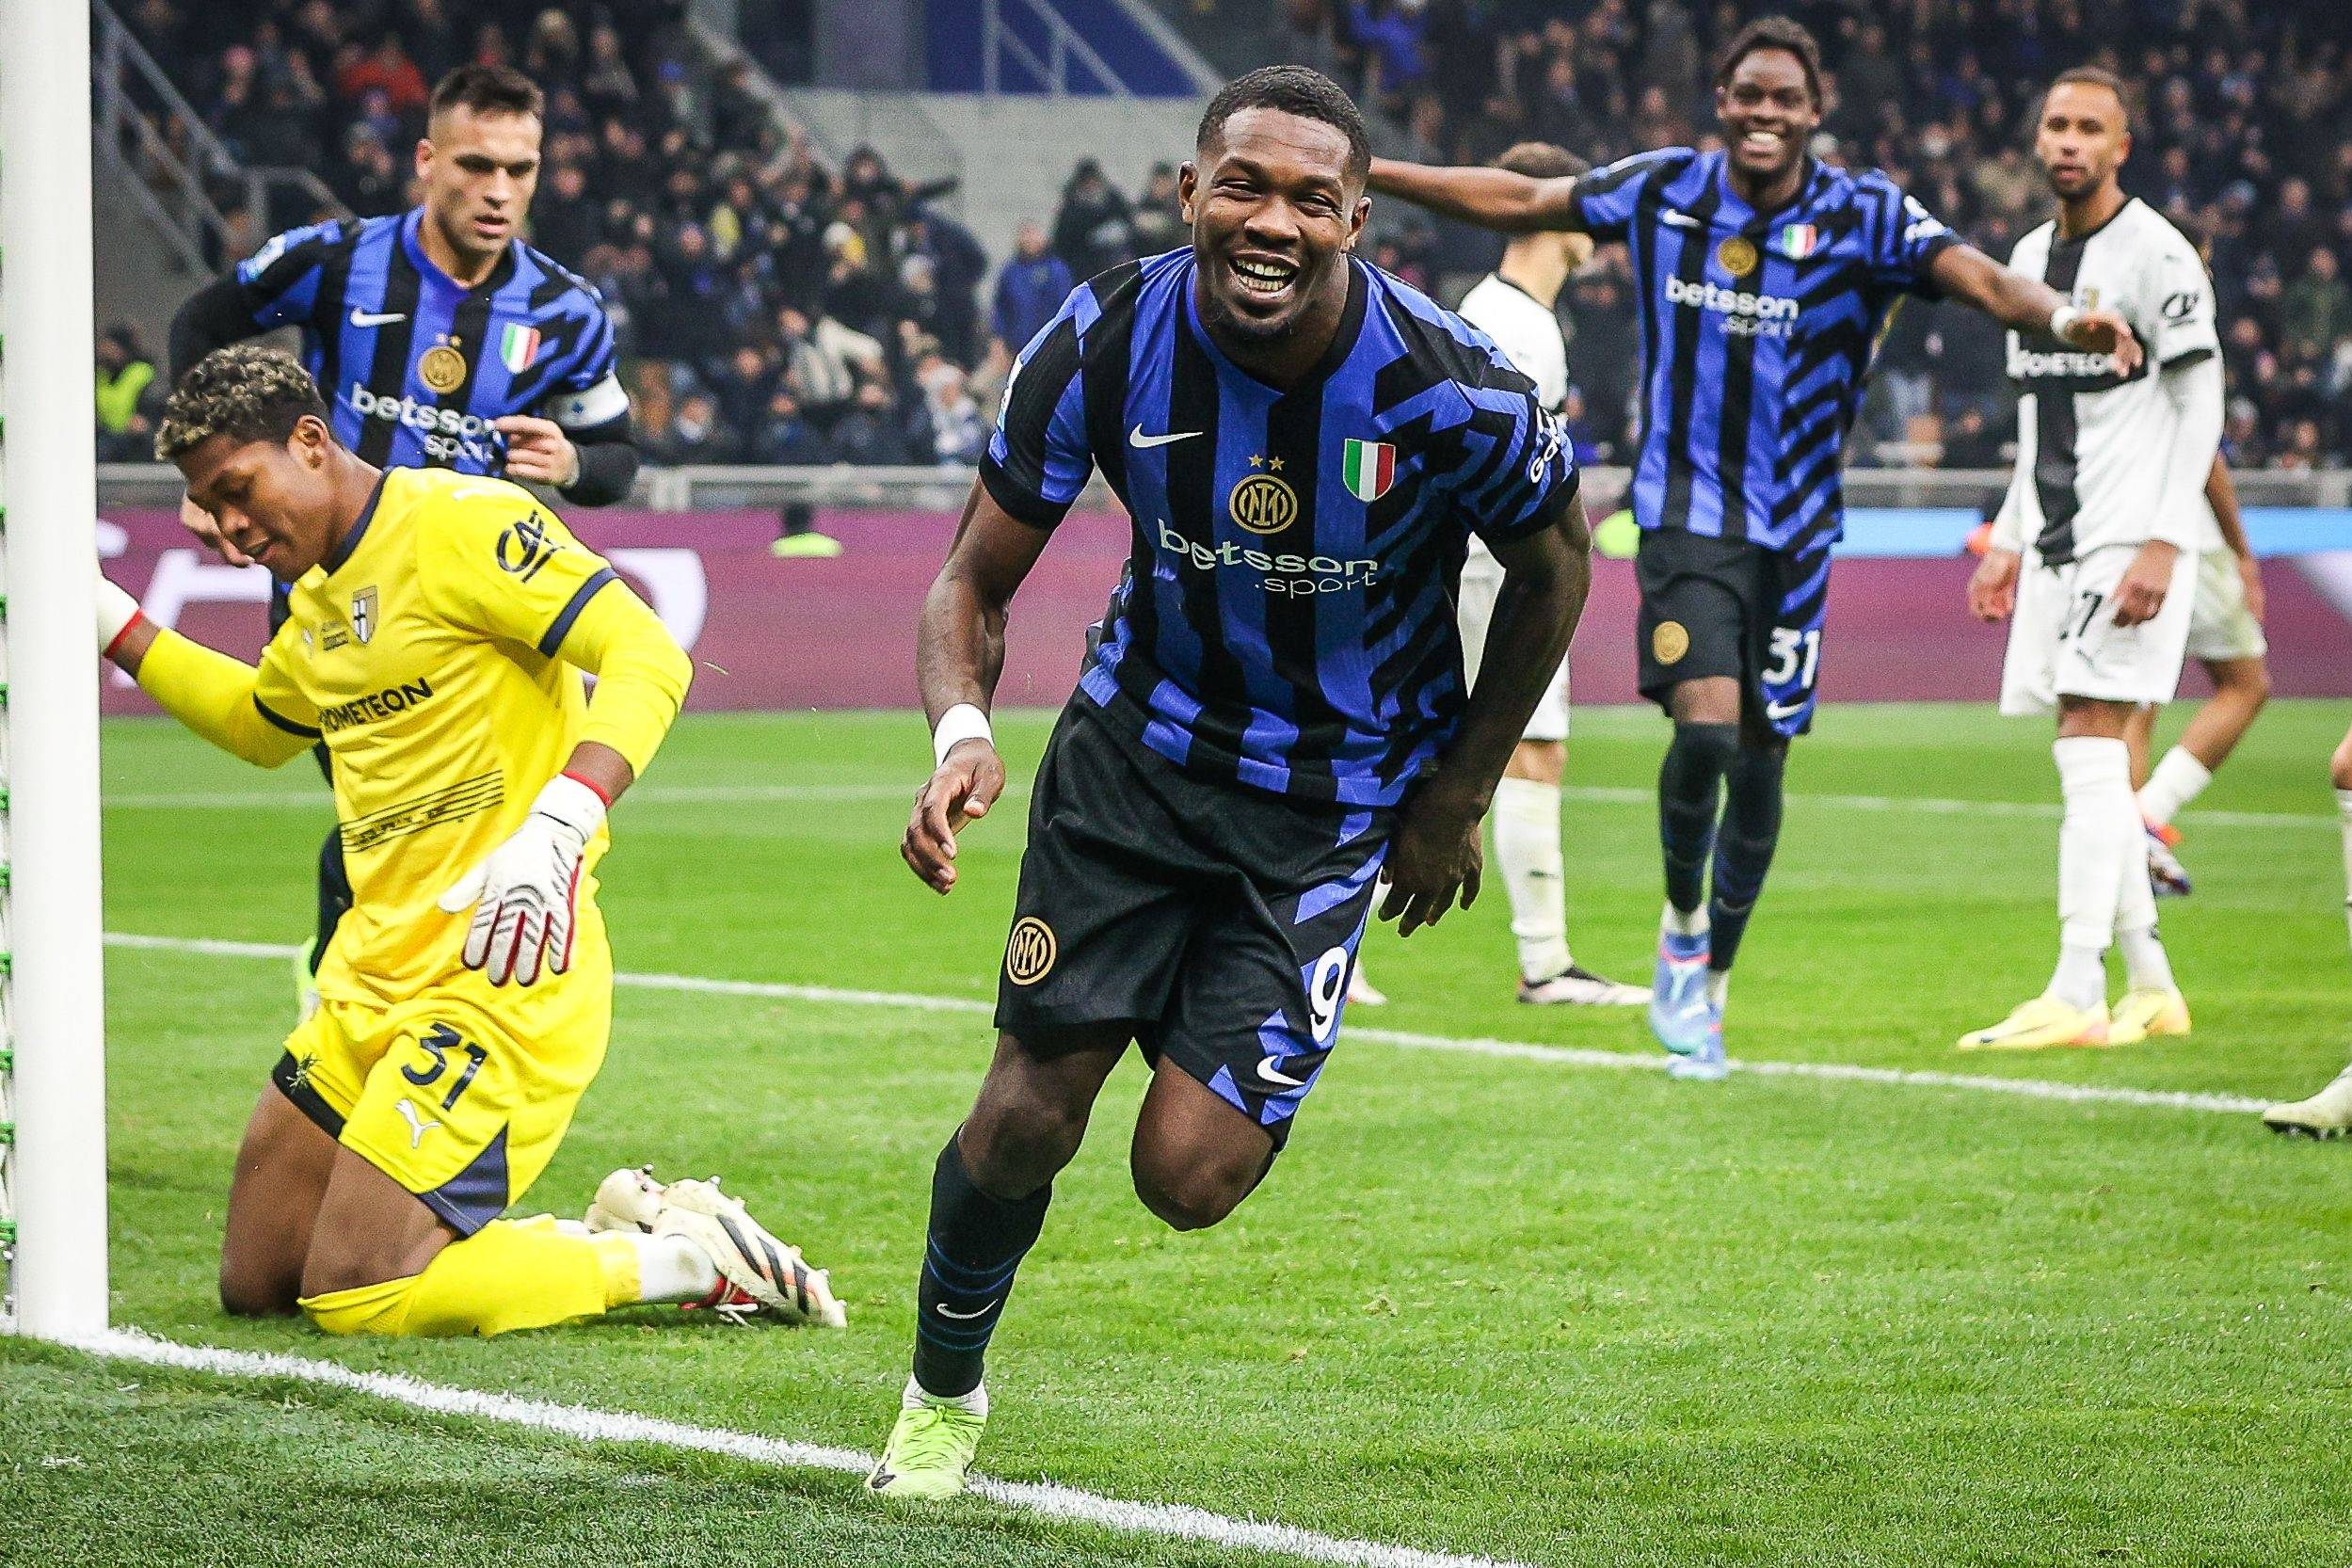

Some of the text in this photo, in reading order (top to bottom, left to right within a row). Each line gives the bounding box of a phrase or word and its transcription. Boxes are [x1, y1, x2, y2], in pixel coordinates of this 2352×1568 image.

[1666, 273, 1799, 321] betsson
[1157, 518, 1378, 576] betsson
[1761, 626, 1820, 689] 31
[1310, 946, 1348, 1042] 9
[401, 1022, 488, 1112] 31
